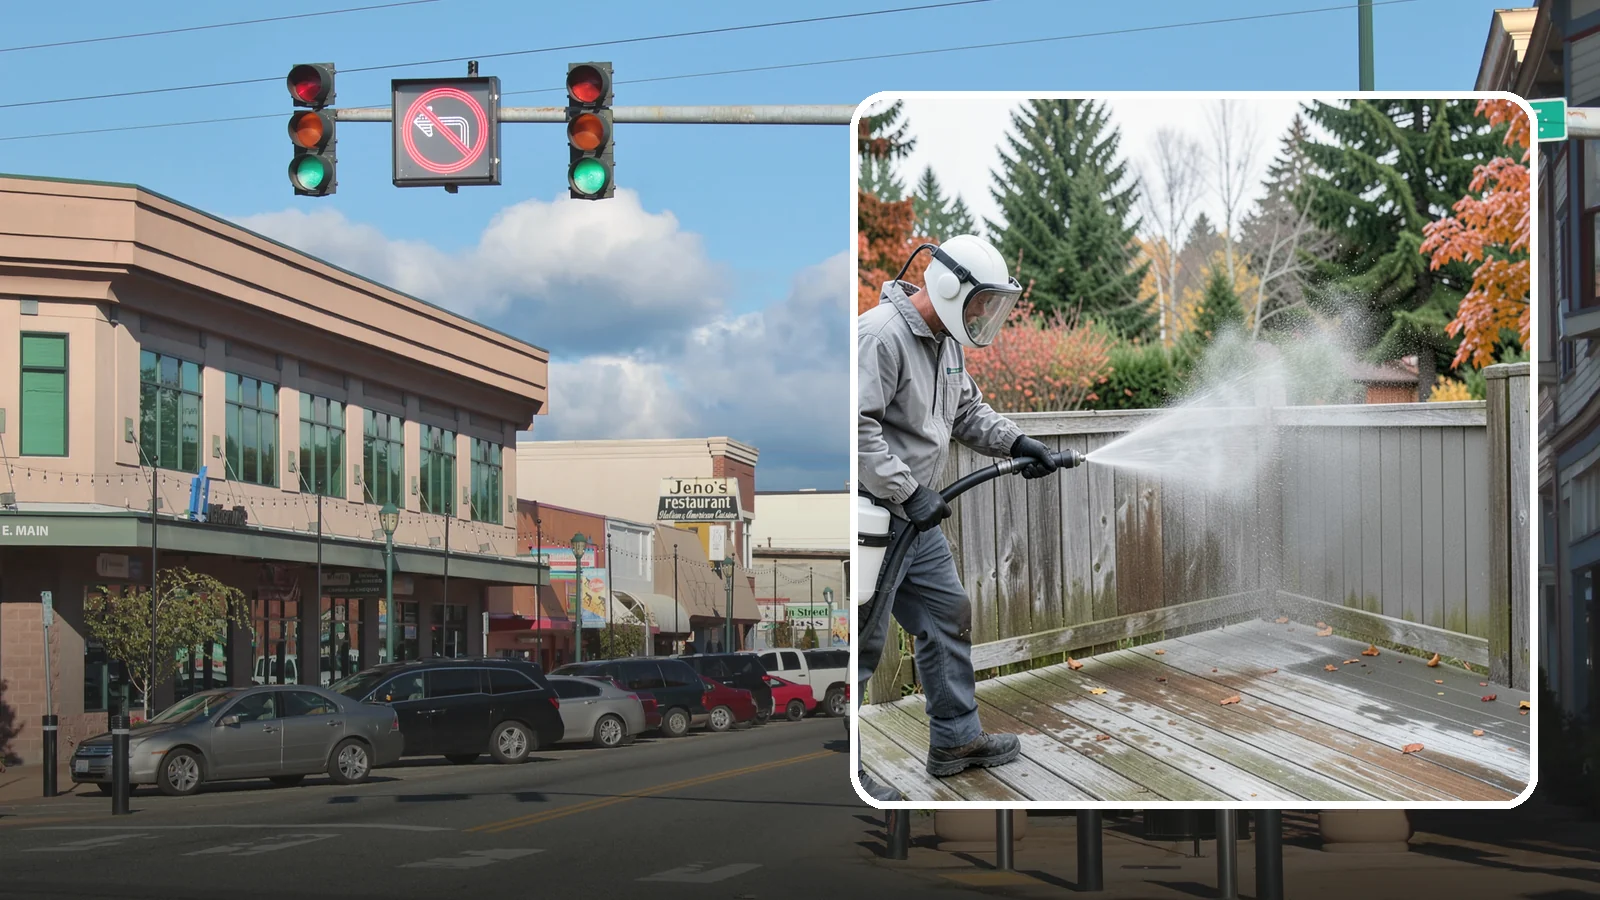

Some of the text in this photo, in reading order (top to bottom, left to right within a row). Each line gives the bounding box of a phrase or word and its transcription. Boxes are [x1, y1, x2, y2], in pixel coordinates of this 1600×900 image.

[670, 480, 727, 494] Jeno's
[665, 496, 731, 509] restaurant
[659, 510, 681, 520] Italian
[686, 510, 714, 519] American
[715, 509, 738, 519] Cuisine
[2, 525, 49, 536] E. MAIN
[797, 608, 828, 617] Street
[791, 618, 823, 627] lass
